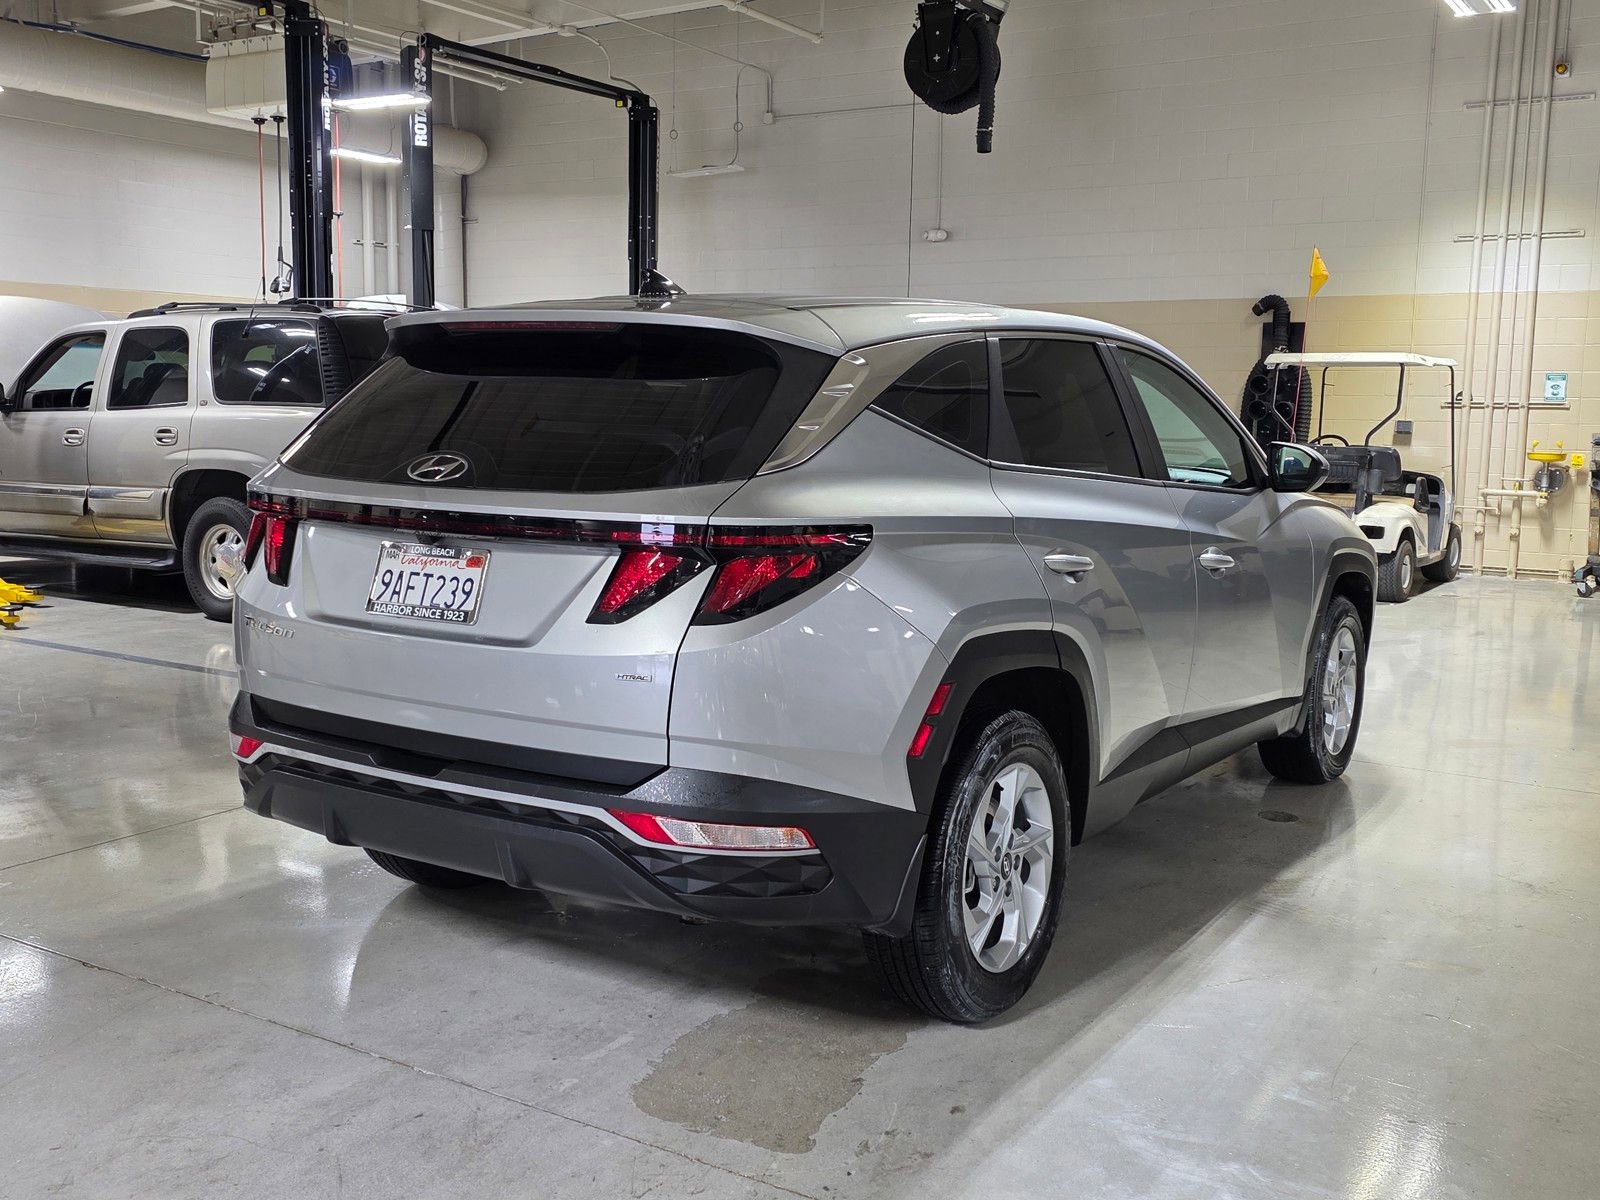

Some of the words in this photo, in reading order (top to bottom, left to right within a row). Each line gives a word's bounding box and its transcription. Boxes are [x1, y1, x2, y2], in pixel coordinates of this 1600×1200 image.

[323, 61, 331, 131] ROARY
[411, 546, 430, 555] LONG
[432, 547, 455, 557] BEACH
[401, 555, 466, 571] California
[375, 569, 475, 610] 9AFT239
[373, 603, 414, 616] HARBOR
[413, 606, 442, 619] SINCE
[443, 610, 465, 621] 1923
